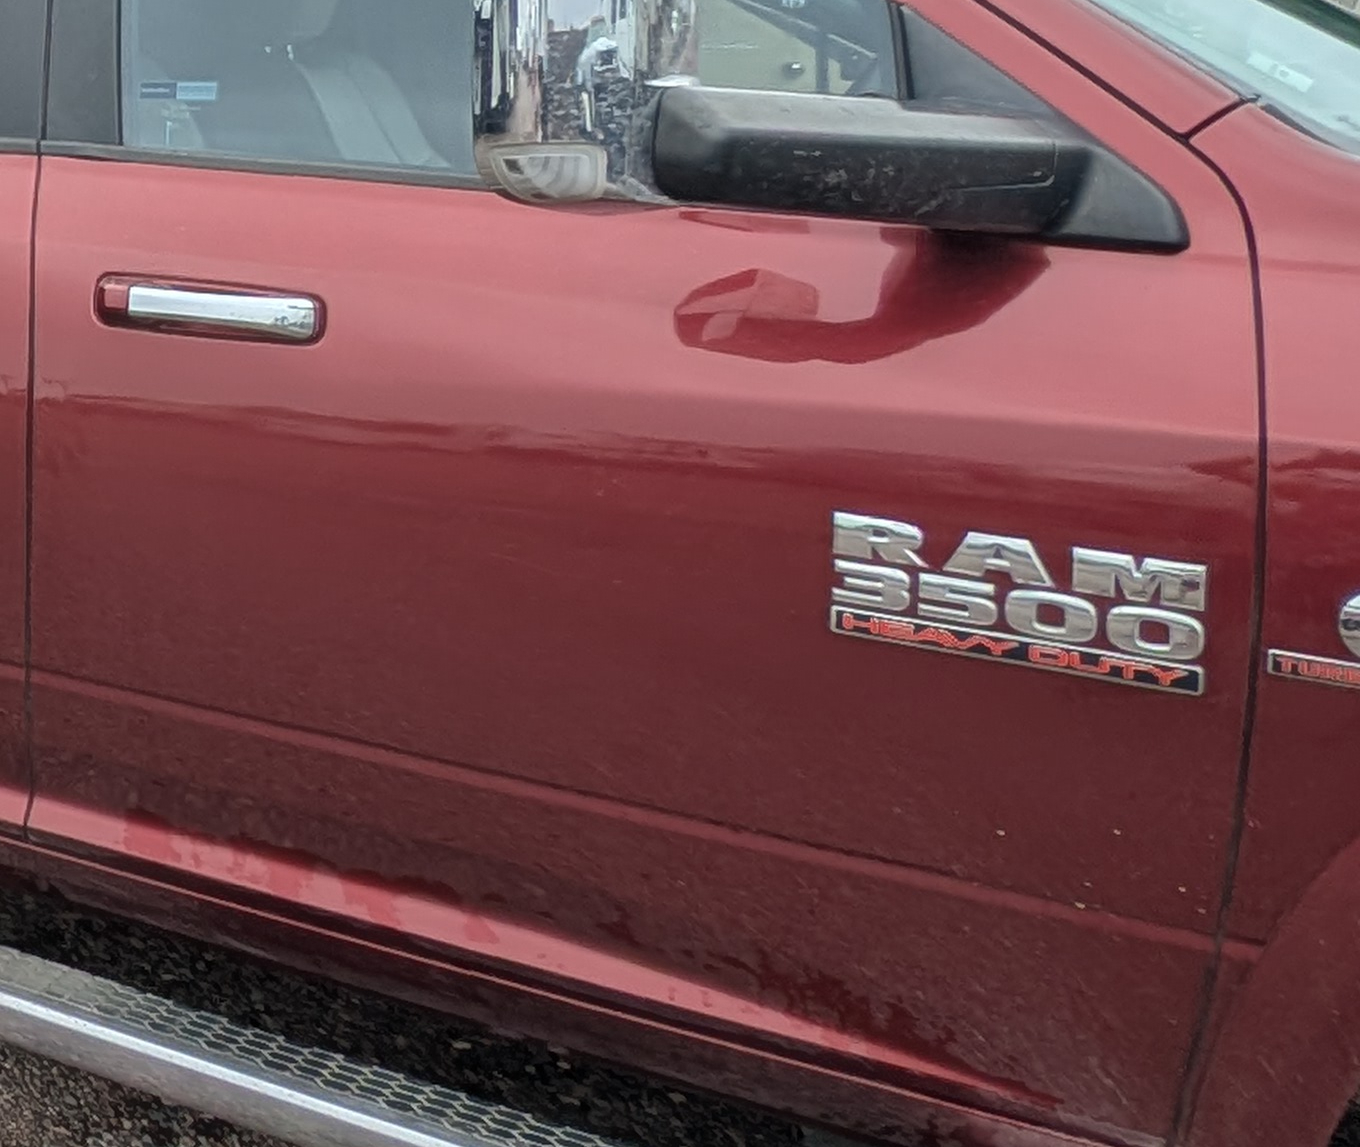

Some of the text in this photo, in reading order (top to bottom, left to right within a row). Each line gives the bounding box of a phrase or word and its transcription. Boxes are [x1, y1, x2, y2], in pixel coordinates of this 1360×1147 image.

[830, 558, 1205, 661] 3500
[831, 510, 1208, 612] RAM
[841, 612, 1190, 688] HEAVY DUTY
